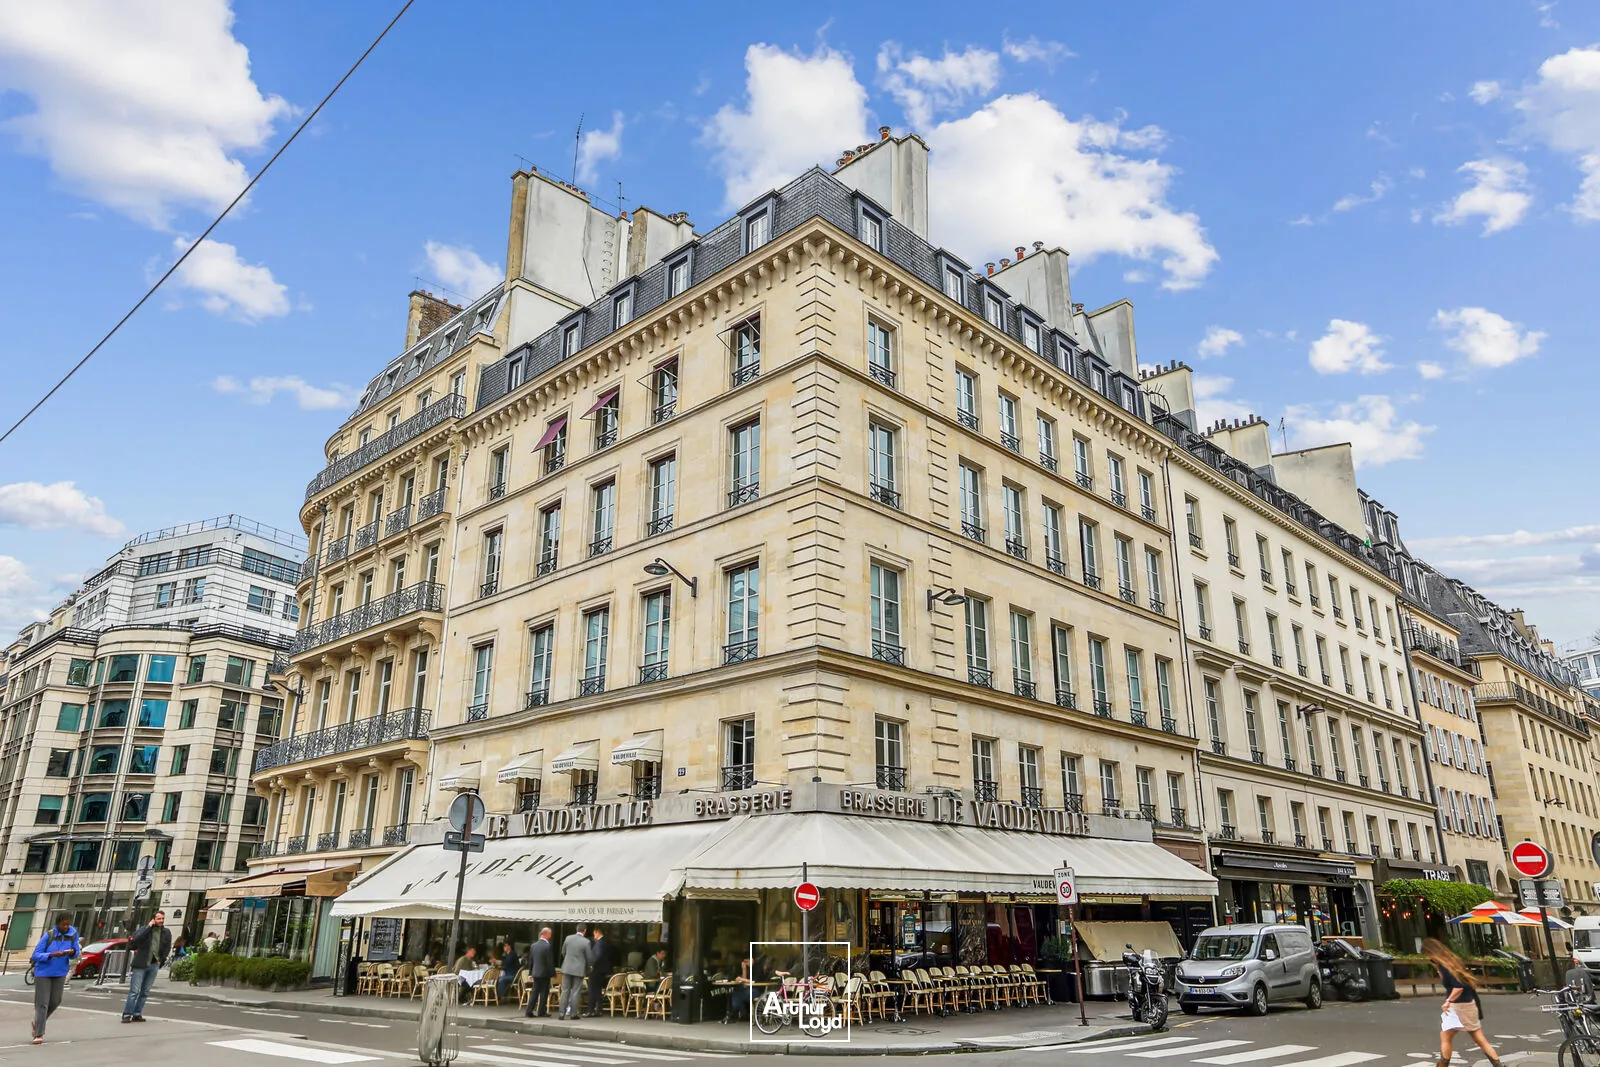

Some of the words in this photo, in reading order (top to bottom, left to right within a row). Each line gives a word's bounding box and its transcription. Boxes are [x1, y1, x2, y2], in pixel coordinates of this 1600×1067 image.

[552, 761, 574, 769] VAUDEVILLE
[612, 751, 637, 760] VAUDEVILLE
[695, 789, 792, 816] BRASSERIE
[840, 789, 927, 816] BRASSERIE
[933, 796, 963, 823] LE
[970, 800, 1091, 835] VAUDEVILLE
[486, 815, 509, 838] LE
[522, 800, 653, 836] VAUDEVILLE
[400, 854, 594, 896] VAUDEVILLE
[1062, 886, 1070, 894] 30
